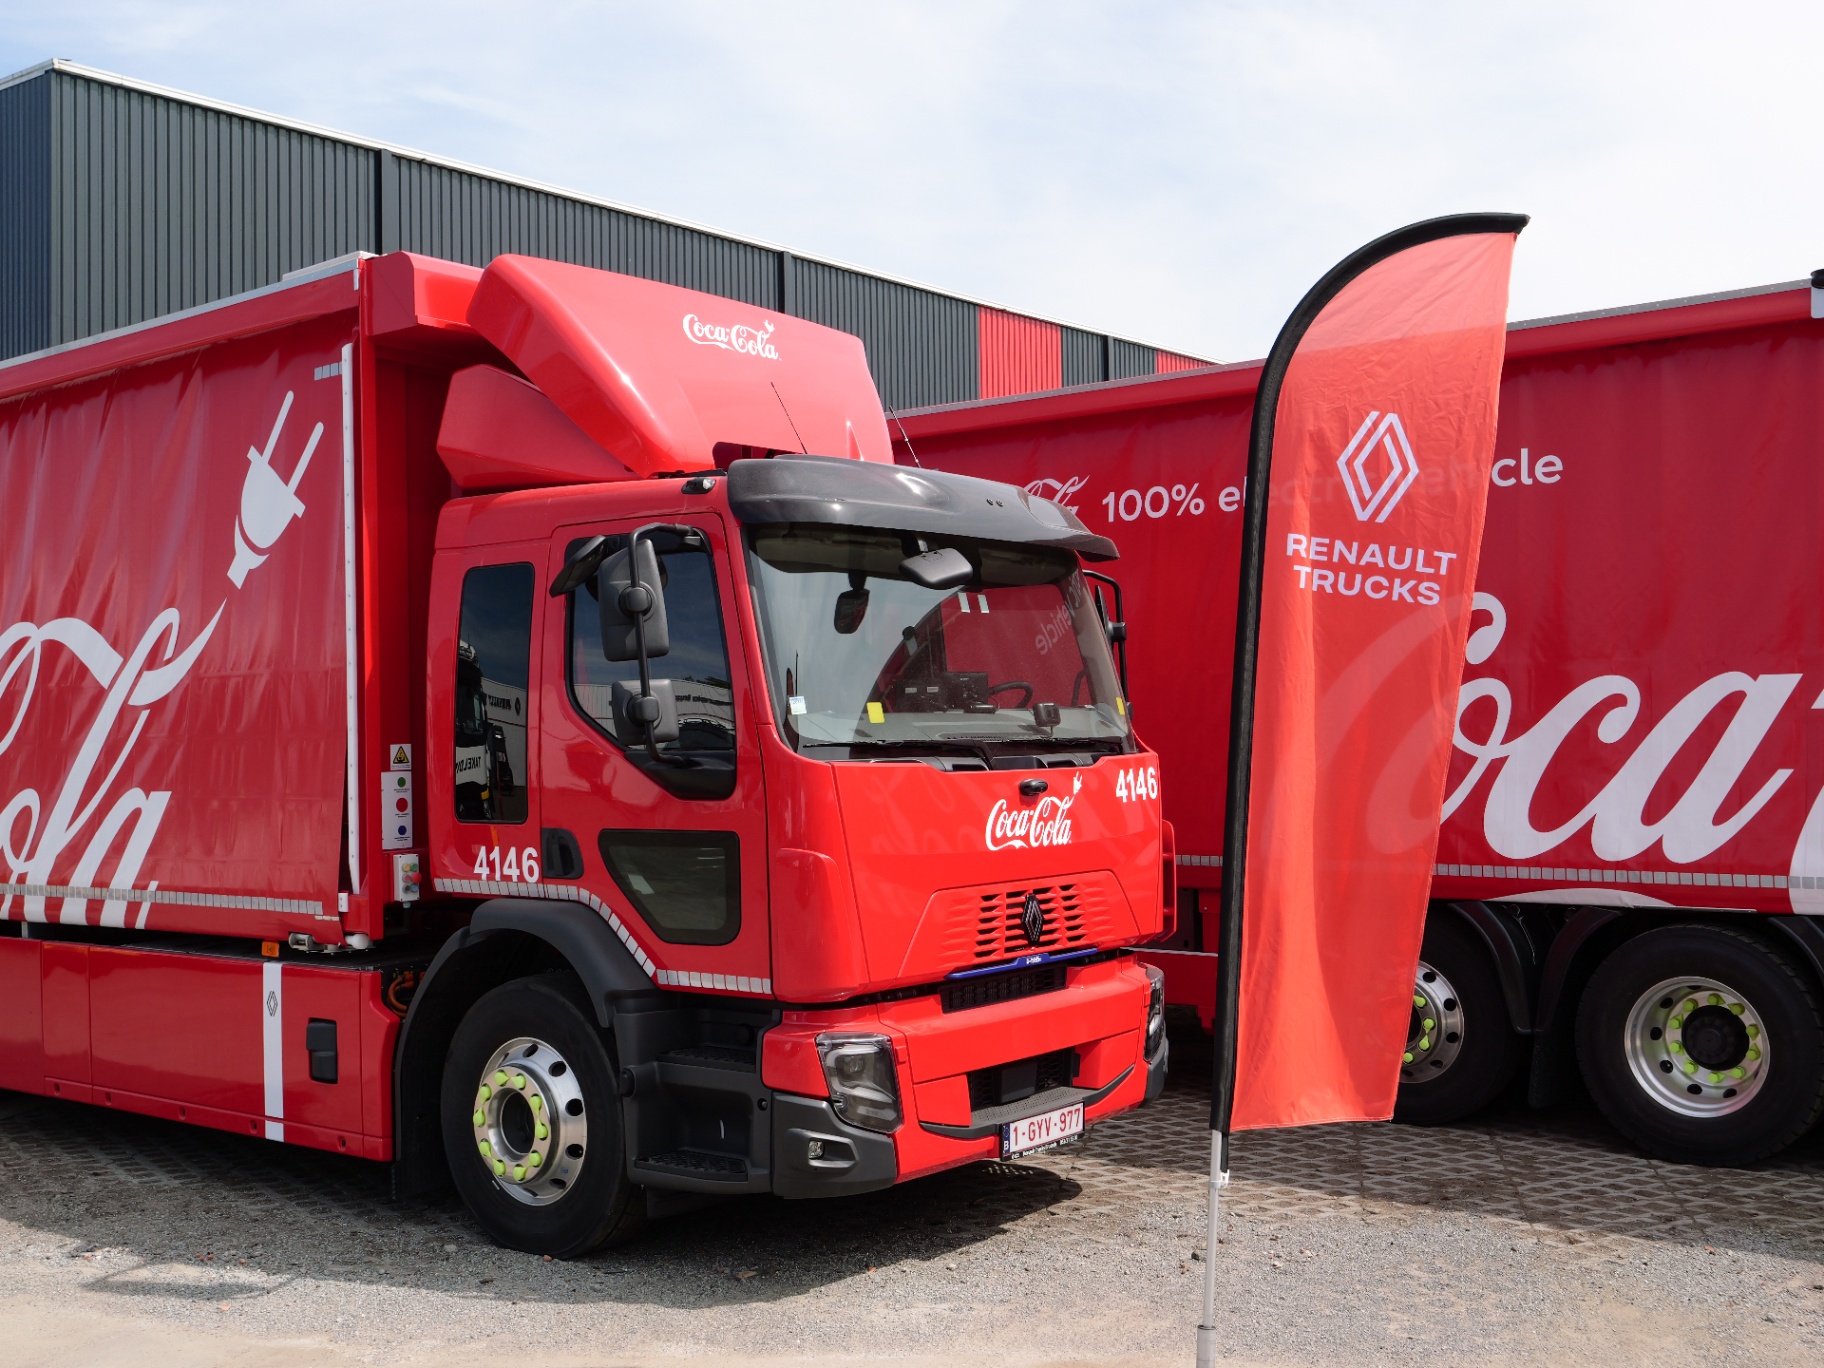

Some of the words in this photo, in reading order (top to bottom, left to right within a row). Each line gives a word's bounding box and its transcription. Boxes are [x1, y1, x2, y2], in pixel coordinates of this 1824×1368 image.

[682, 314, 779, 360] Coca-Cola
[1101, 482, 1206, 523] 100%
[1285, 532, 1458, 577] RENAULT
[1293, 564, 1441, 607] TRUCKS
[1115, 767, 1159, 803] 4146
[985, 793, 1074, 852] Coca-Cola
[473, 845, 540, 884] 4146
[1003, 1140, 1010, 1151] B
[1013, 1108, 1081, 1146] 1-GYV-977
